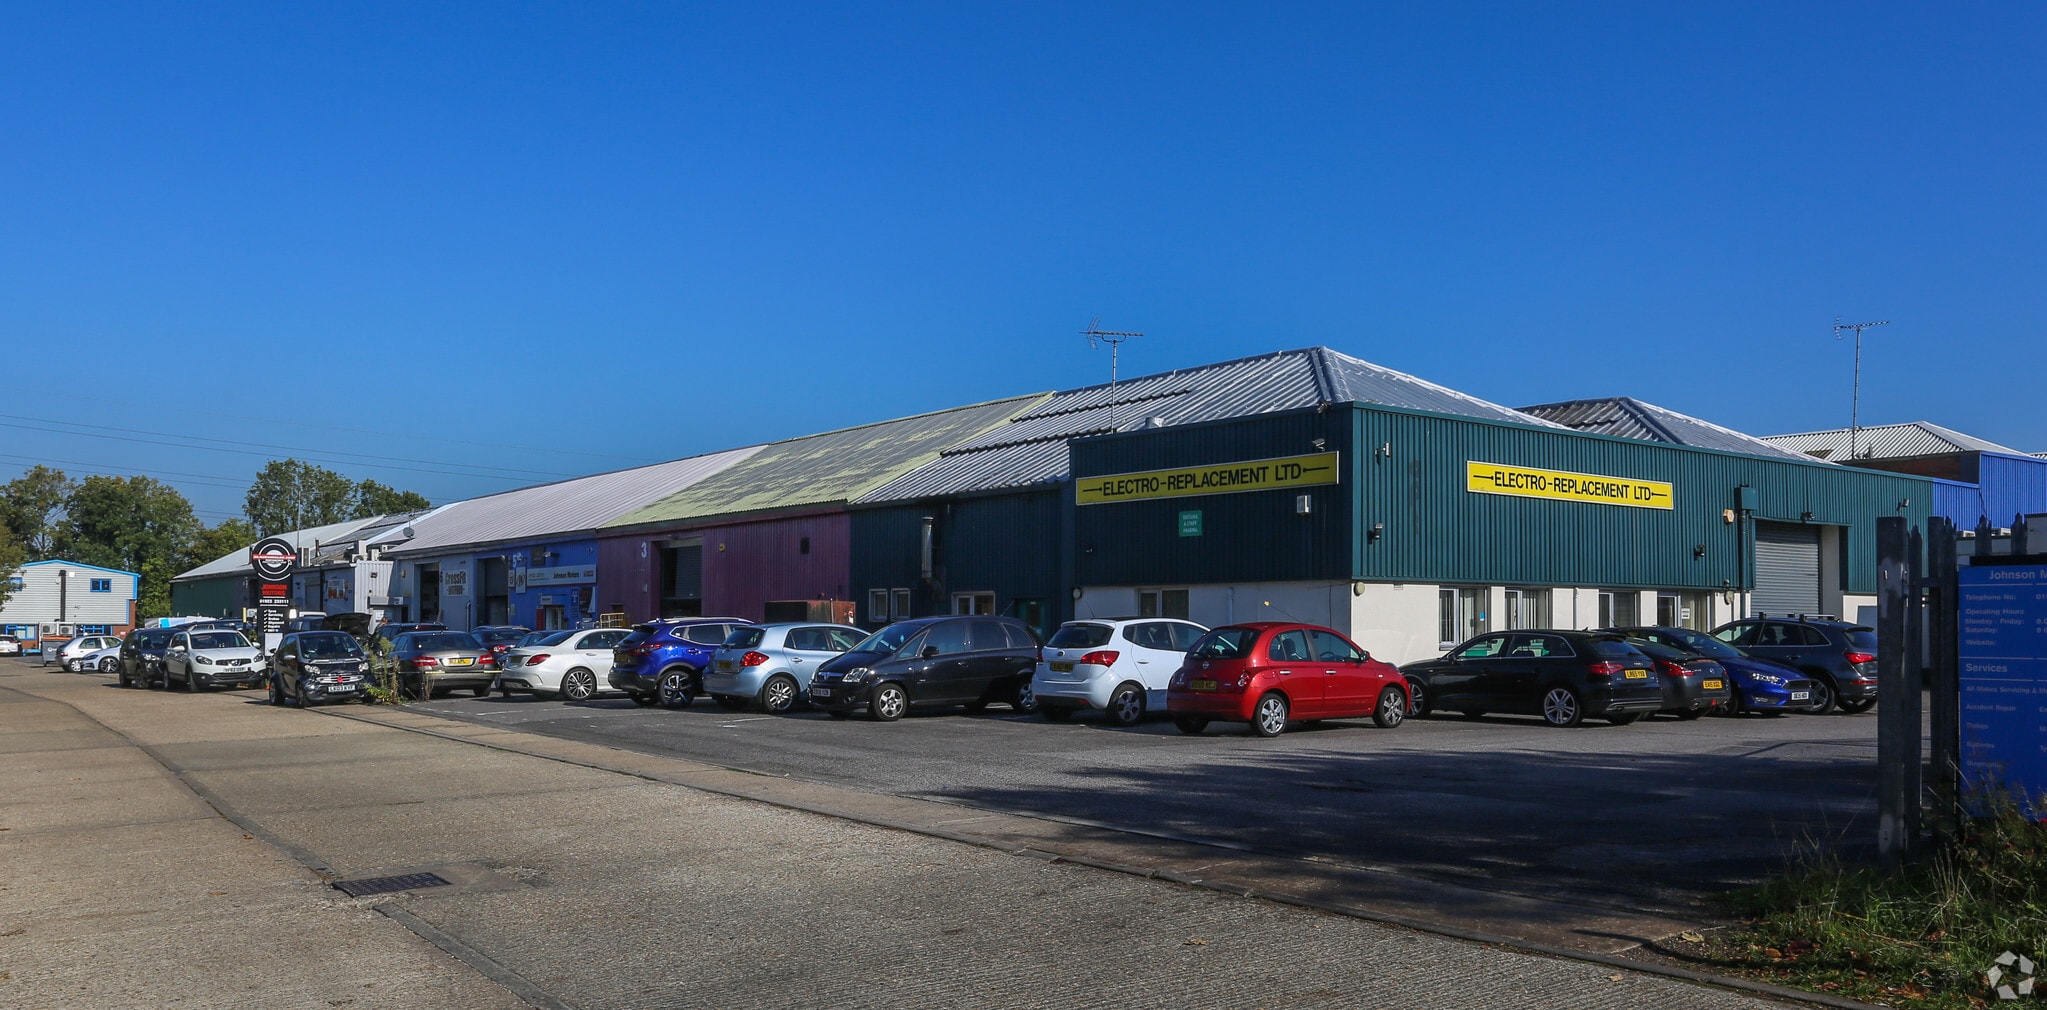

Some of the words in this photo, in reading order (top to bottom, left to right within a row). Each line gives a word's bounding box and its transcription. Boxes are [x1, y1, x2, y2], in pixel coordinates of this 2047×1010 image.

[1103, 466, 1269, 496] ELECTRO-REPLACEMENT
[1275, 463, 1301, 481] LTD
[1494, 472, 1629, 498] ELECTRO-REPLACEMENT
[1634, 486, 1652, 501] LTD
[641, 541, 647, 558] 3
[1989, 570, 2036, 580] Johnson
[1965, 593, 2001, 601] Telephone
[1965, 608, 2001, 616] Operating
[1965, 618, 1993, 626] Monday
[1965, 663, 2008, 673] Services
[1999, 686, 2031, 695] Servicing
[1966, 703, 1994, 711] Accident
[1995, 704, 2017, 712] Repair
